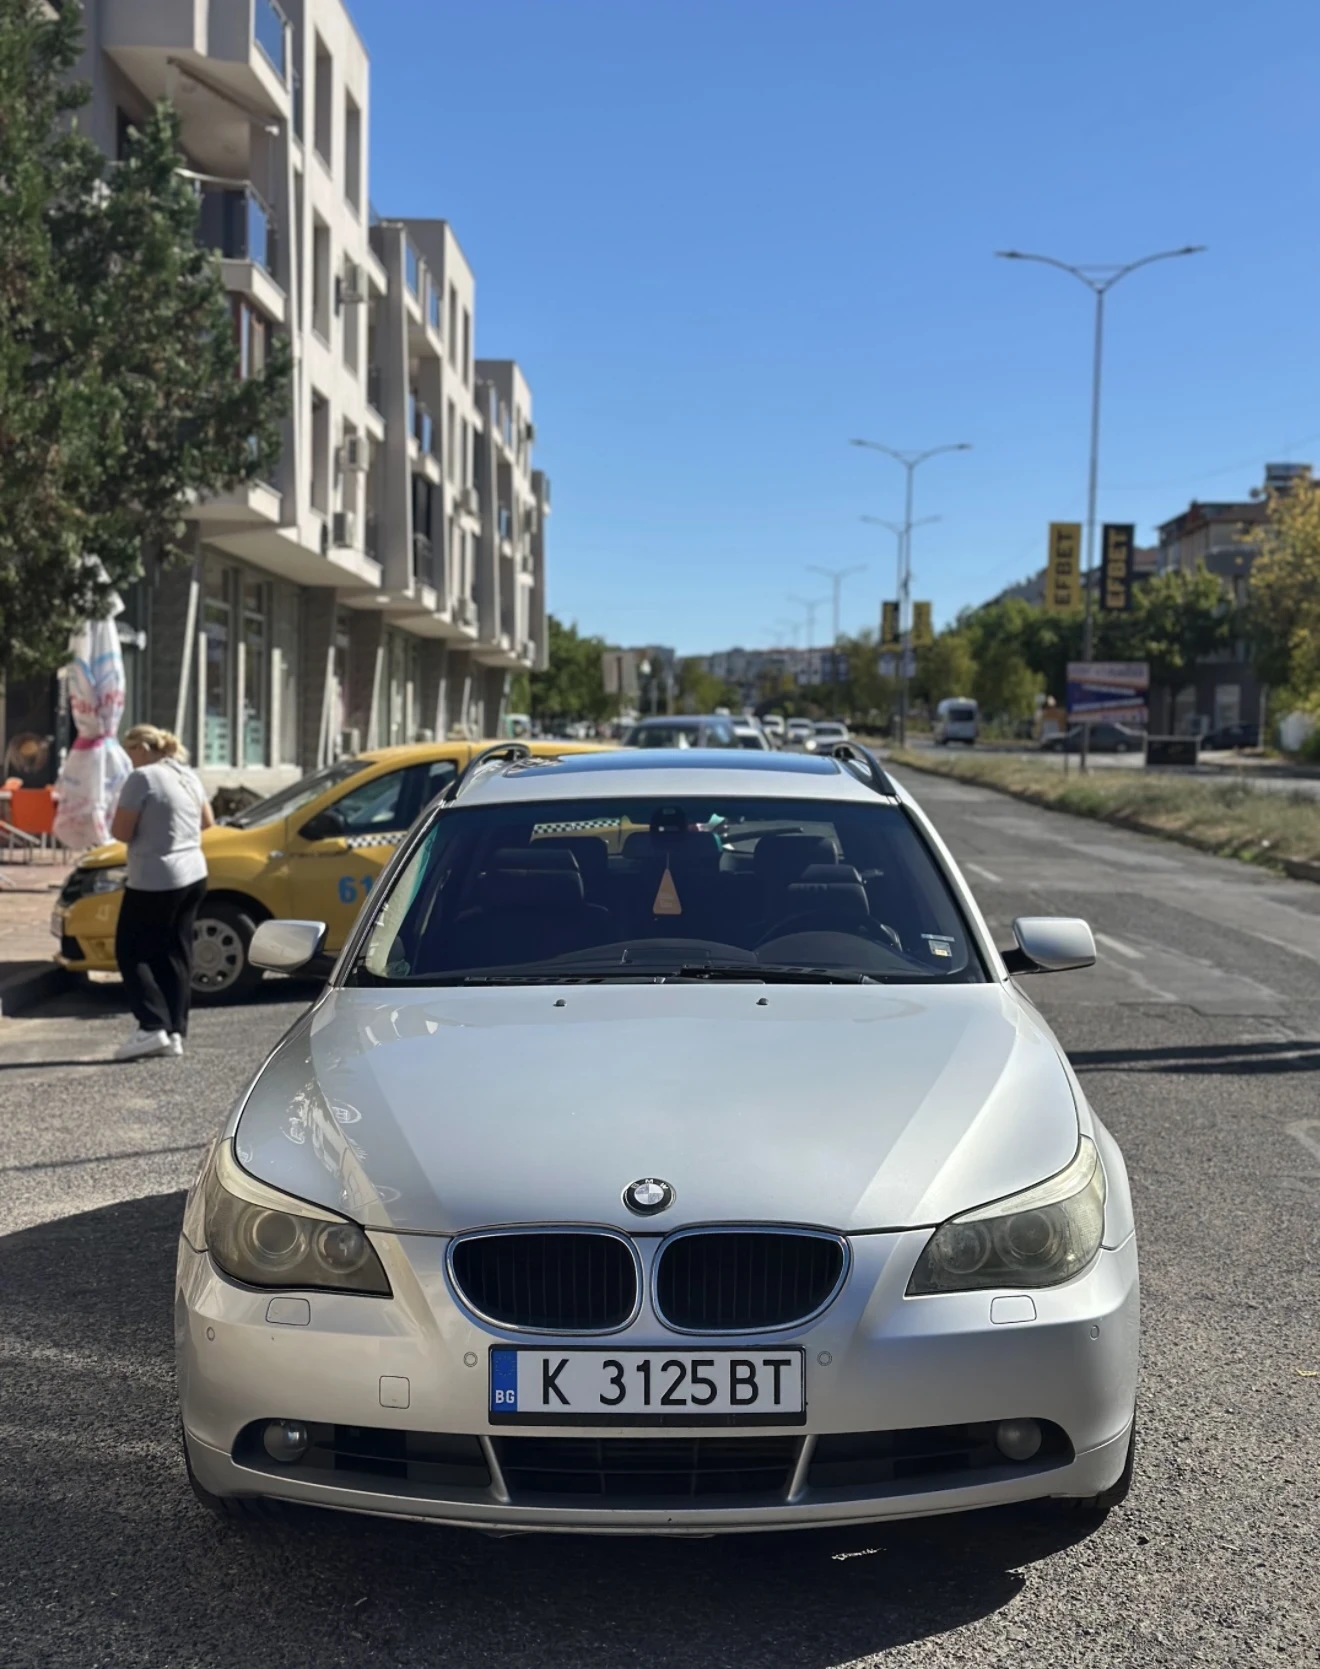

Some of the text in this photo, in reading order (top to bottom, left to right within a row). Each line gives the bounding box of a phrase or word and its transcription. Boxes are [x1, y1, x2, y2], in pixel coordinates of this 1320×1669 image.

[1054, 528, 1075, 605] EFBET
[630, 1178, 669, 1189] BMW
[495, 1389, 515, 1404] BG
[542, 1358, 571, 1405] K
